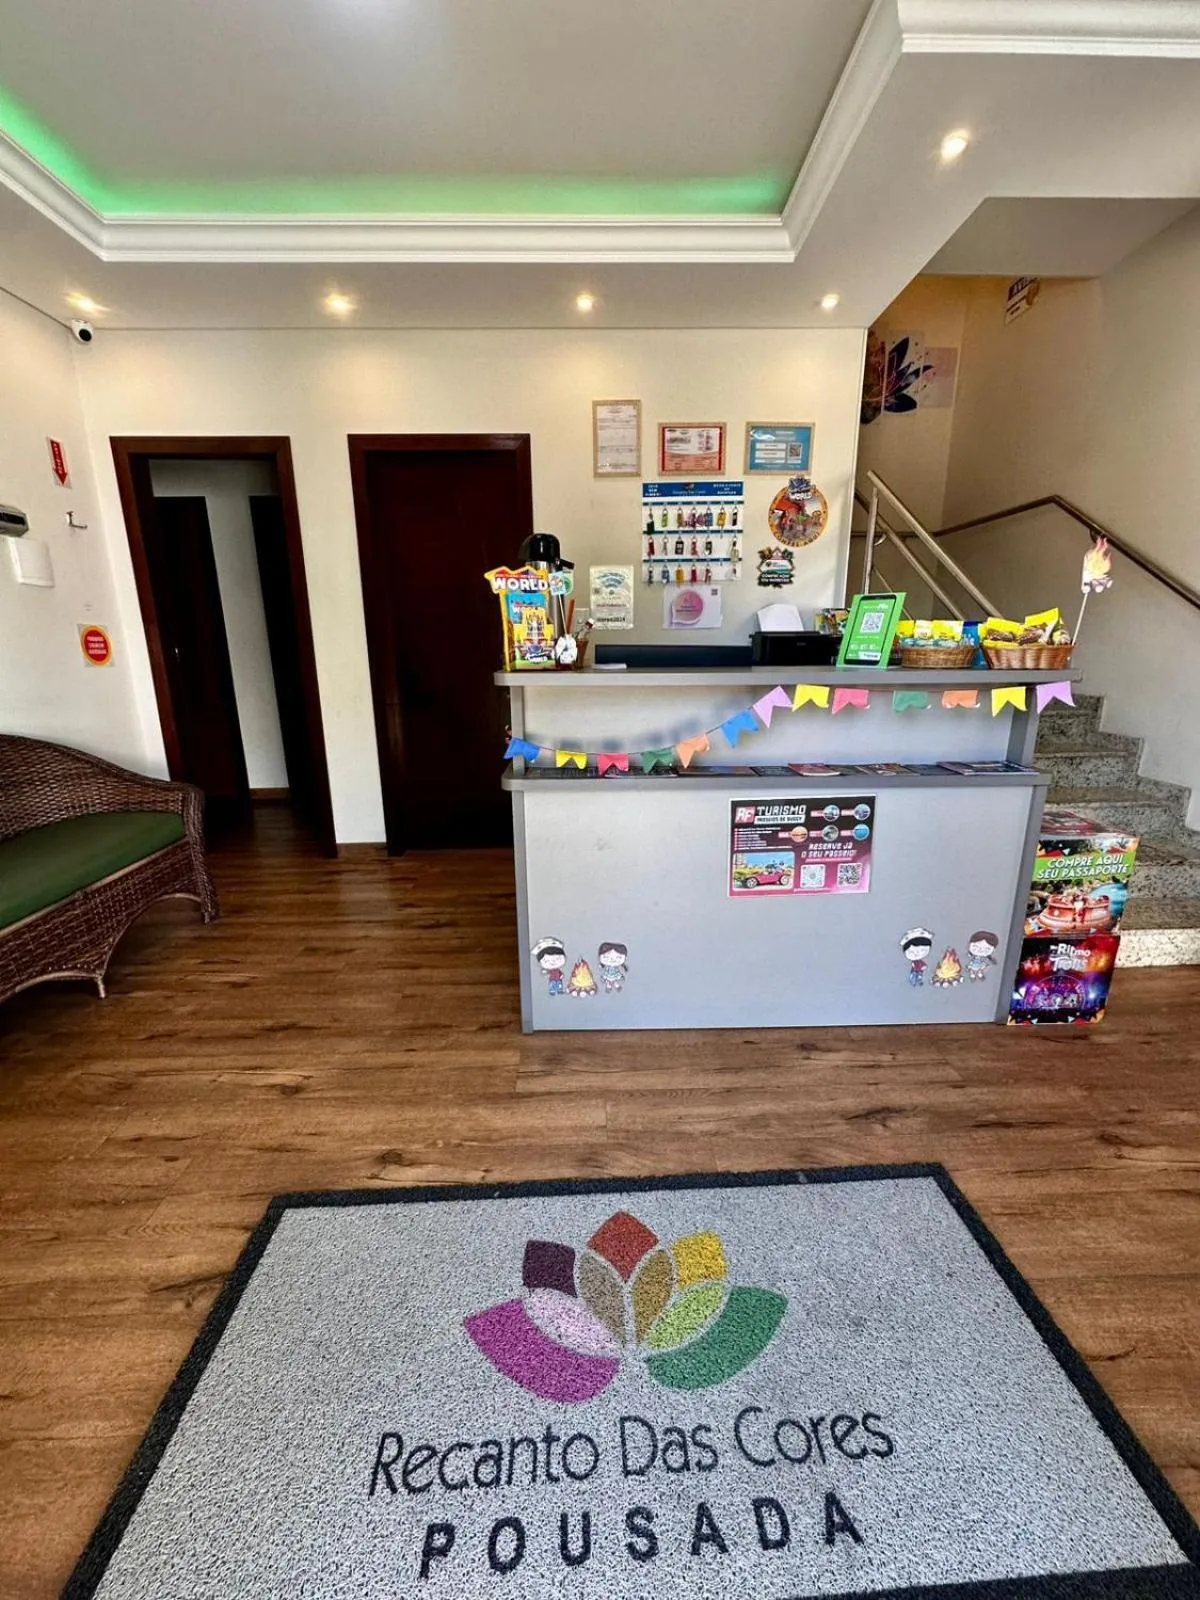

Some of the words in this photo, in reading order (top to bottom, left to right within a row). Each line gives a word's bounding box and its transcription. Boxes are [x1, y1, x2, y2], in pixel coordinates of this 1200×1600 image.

[494, 577, 548, 591] WORLD
[757, 805, 806, 815] TURISMO
[808, 842, 841, 850] RESERVE
[808, 850, 823, 858] SEU
[1048, 857, 1092, 868] COMPRE
[1096, 854, 1123, 864] AQUI
[1038, 869, 1059, 878] SEU
[1062, 865, 1128, 878] PASSAPORTE
[1057, 943, 1091, 957] Ritmo
[368, 1428, 599, 1498] Recanto
[620, 1415, 718, 1478] Das
[733, 1406, 894, 1468] Cores
[418, 1492, 864, 1579] POUSADA
